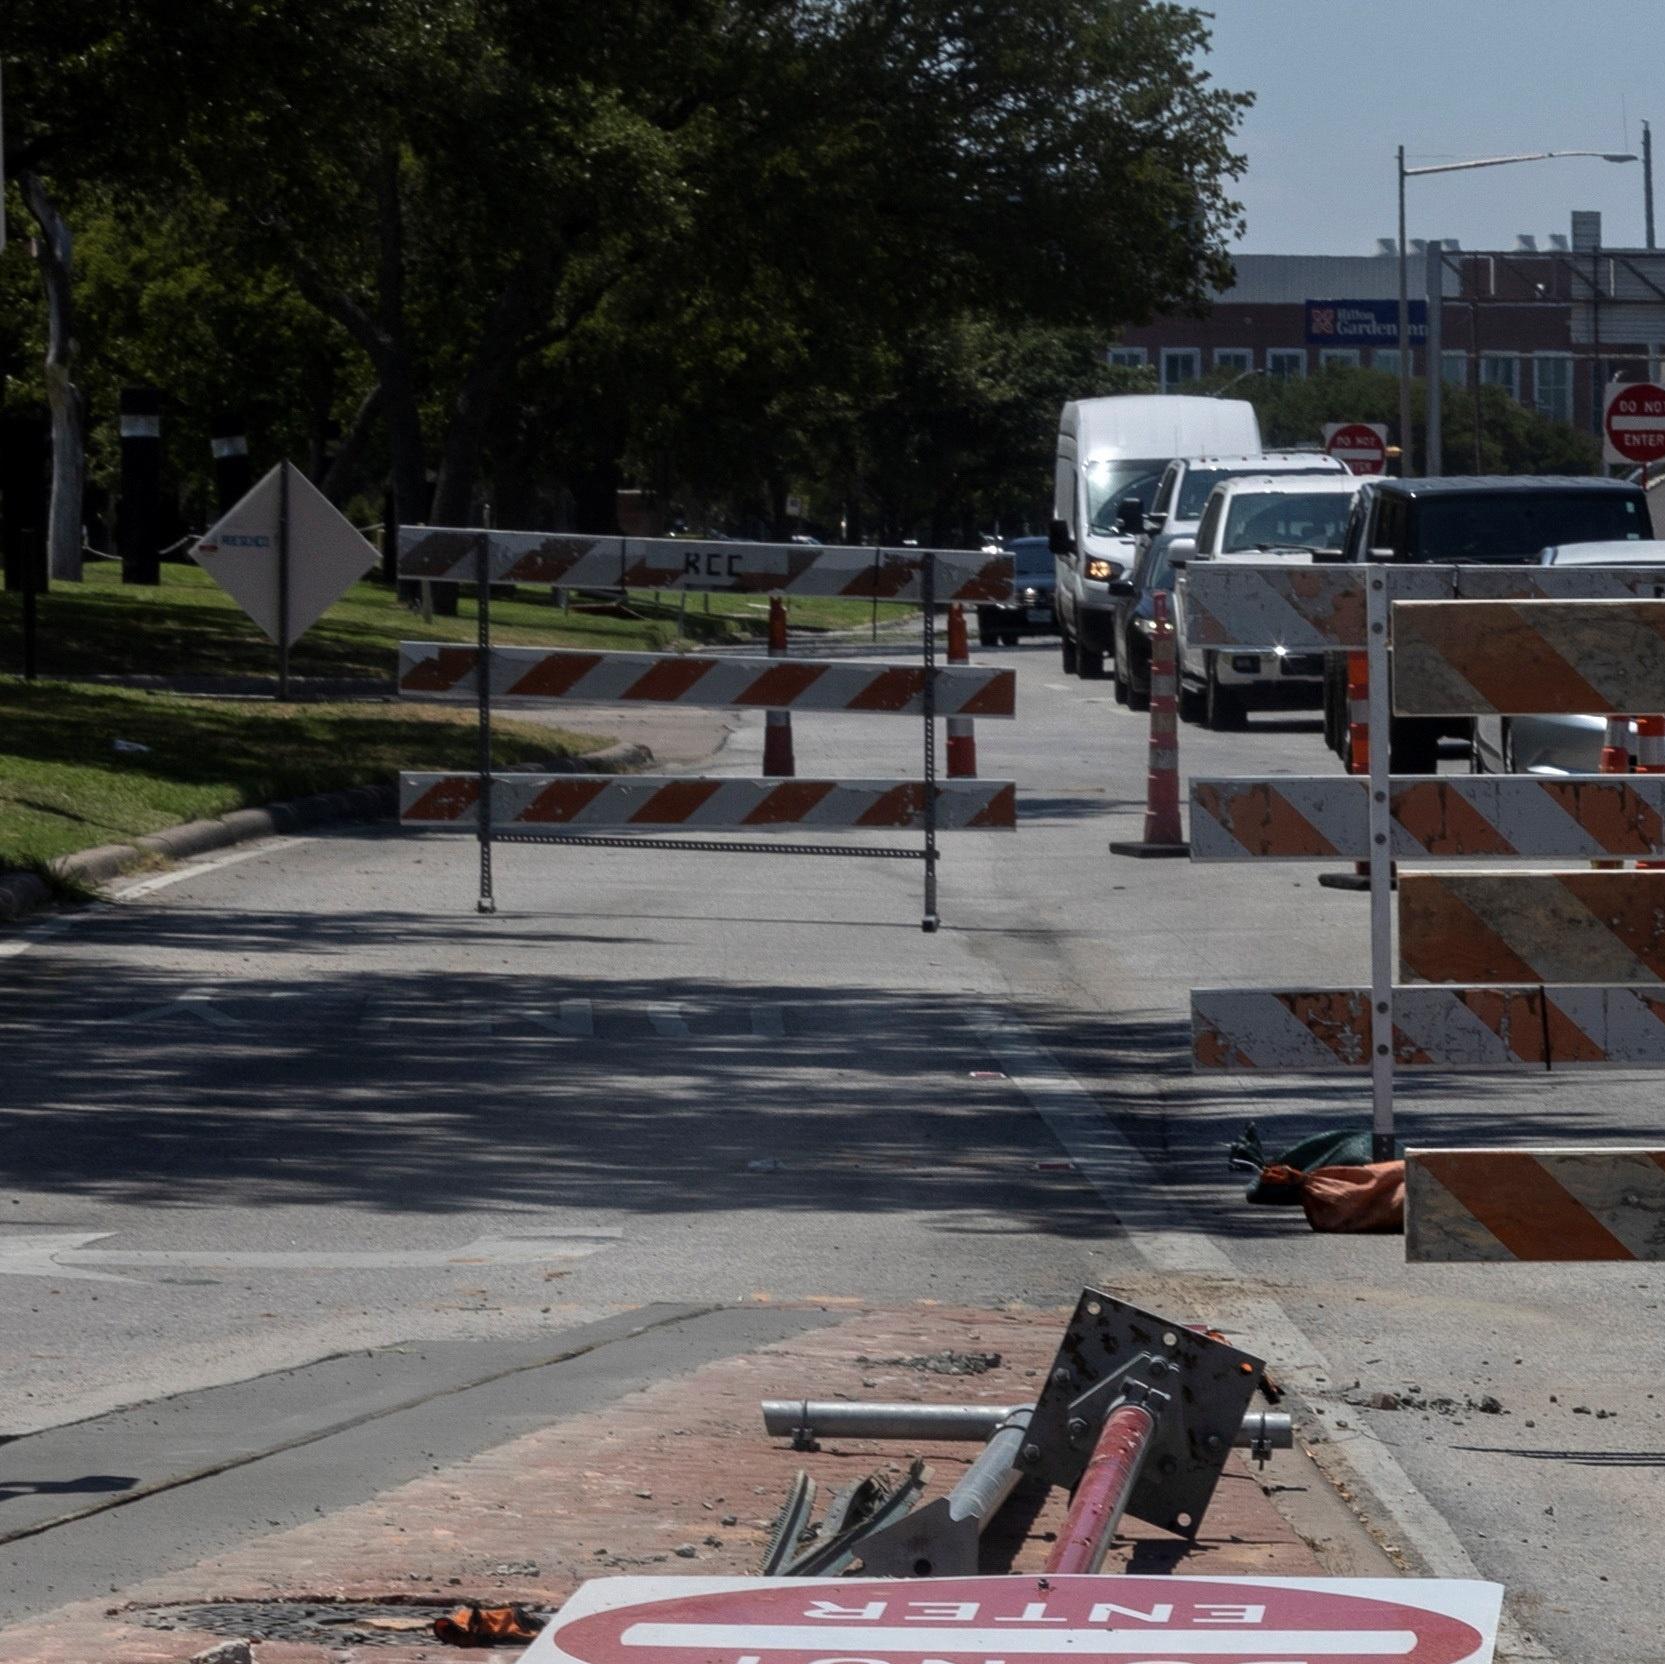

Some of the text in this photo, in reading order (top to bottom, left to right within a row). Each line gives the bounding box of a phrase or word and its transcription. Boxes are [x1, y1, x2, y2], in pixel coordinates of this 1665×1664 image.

[1337, 309, 1374, 320] Hilton
[1337, 320, 1398, 335] Garden
[1620, 401, 1637, 413] DO
[1624, 434, 1665, 446] ENTER
[684, 552, 742, 577] RCC
[804, 1600, 1266, 1623] ENTER
